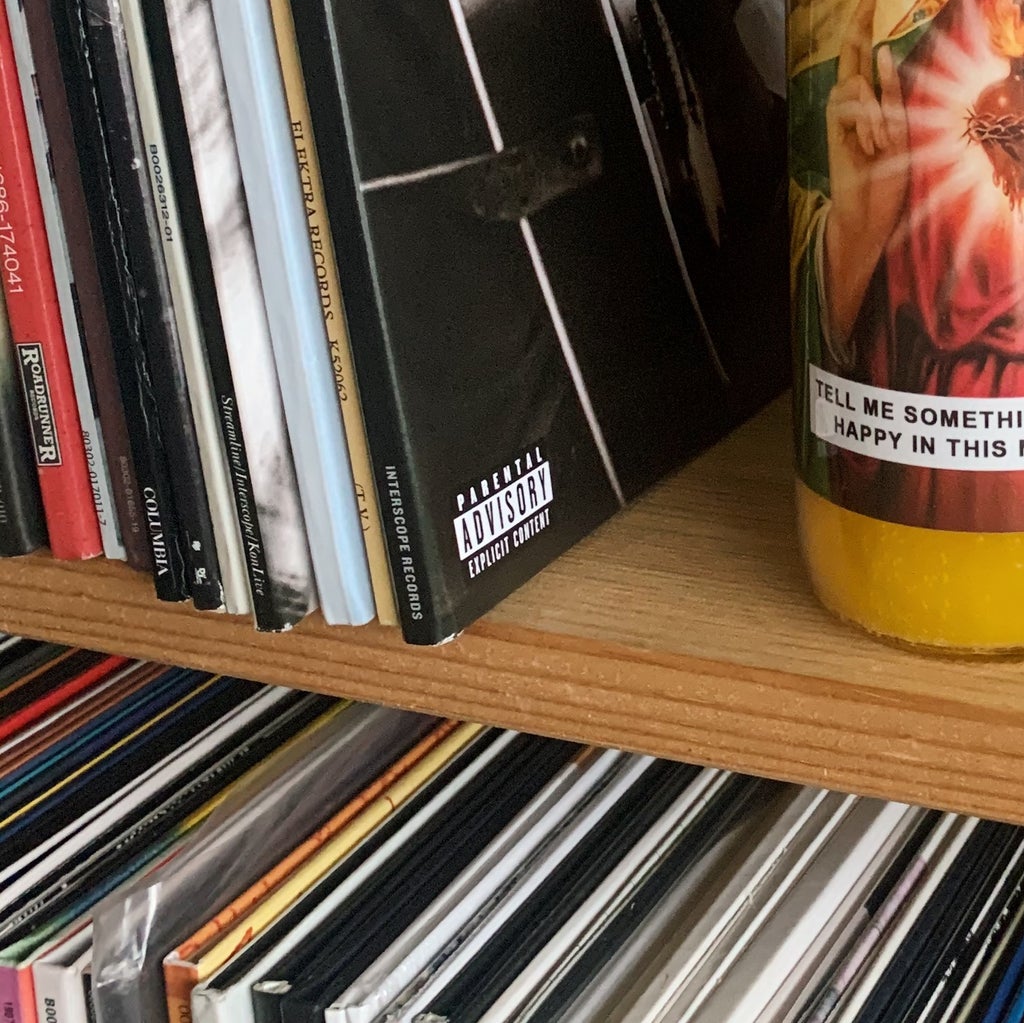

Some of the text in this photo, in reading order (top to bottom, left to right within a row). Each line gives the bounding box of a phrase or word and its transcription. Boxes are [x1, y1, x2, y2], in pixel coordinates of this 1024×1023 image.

[149, 144, 173, 243] B0026312-01
[292, 120, 316, 217] ELEKTRA
[310, 225, 334, 321] RECORDS
[21, 347, 58, 464] ROADRUNNER
[815, 378, 856, 412] TELL
[863, 396, 894, 421] ME
[834, 415, 902, 451] HAPPY
[912, 434, 936, 456] IN
[946, 438, 1007, 459] THIS
[456, 446, 543, 511] PARENTAL
[461, 467, 547, 553] ADVISORY
[144, 487, 170, 576] COLUMBIA
[385, 465, 422, 621] INTERSCOPE RECORDS
[468, 508, 550, 578] EXPLICIT CONTENT
